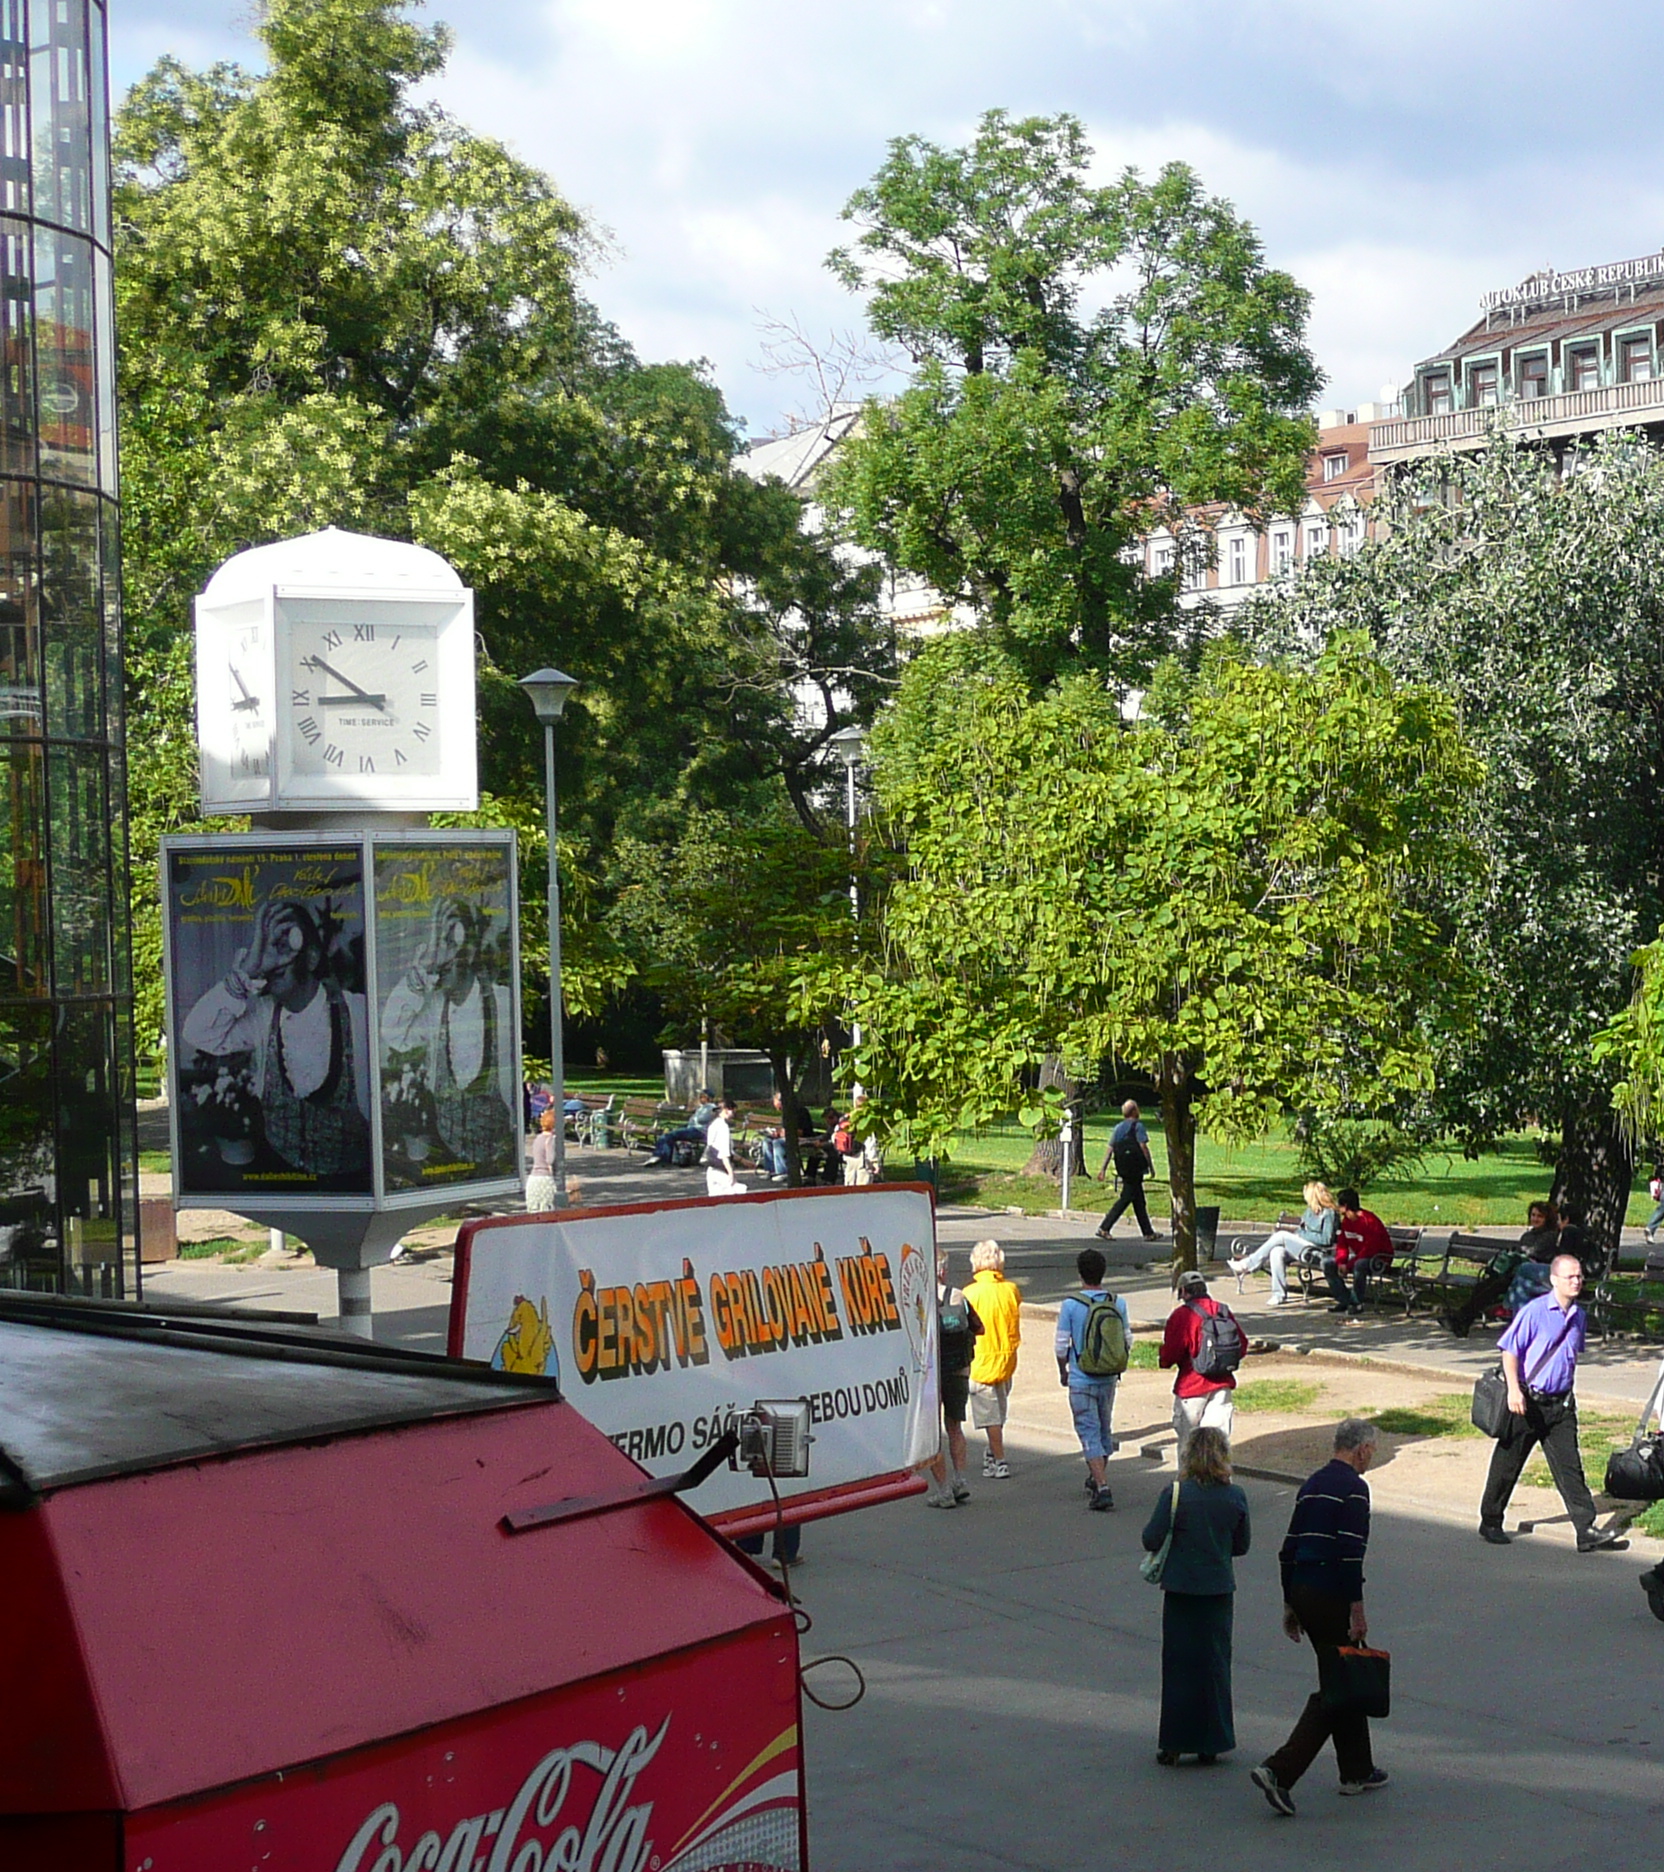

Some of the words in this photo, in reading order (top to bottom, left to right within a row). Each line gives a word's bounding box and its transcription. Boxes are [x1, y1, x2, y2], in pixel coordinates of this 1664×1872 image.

[1479, 279, 1548, 308] AUTOKLUB
[1551, 266, 1595, 294] ČESKÉ
[354, 624, 374, 641] XII
[572, 1258, 708, 1383] ČERSTVÉ
[710, 1242, 843, 1361] GRILOVANÉ
[835, 1236, 901, 1338] KUŘE
[799, 1388, 861, 1424] EBOU
[866, 1367, 909, 1413] DOMŮ
